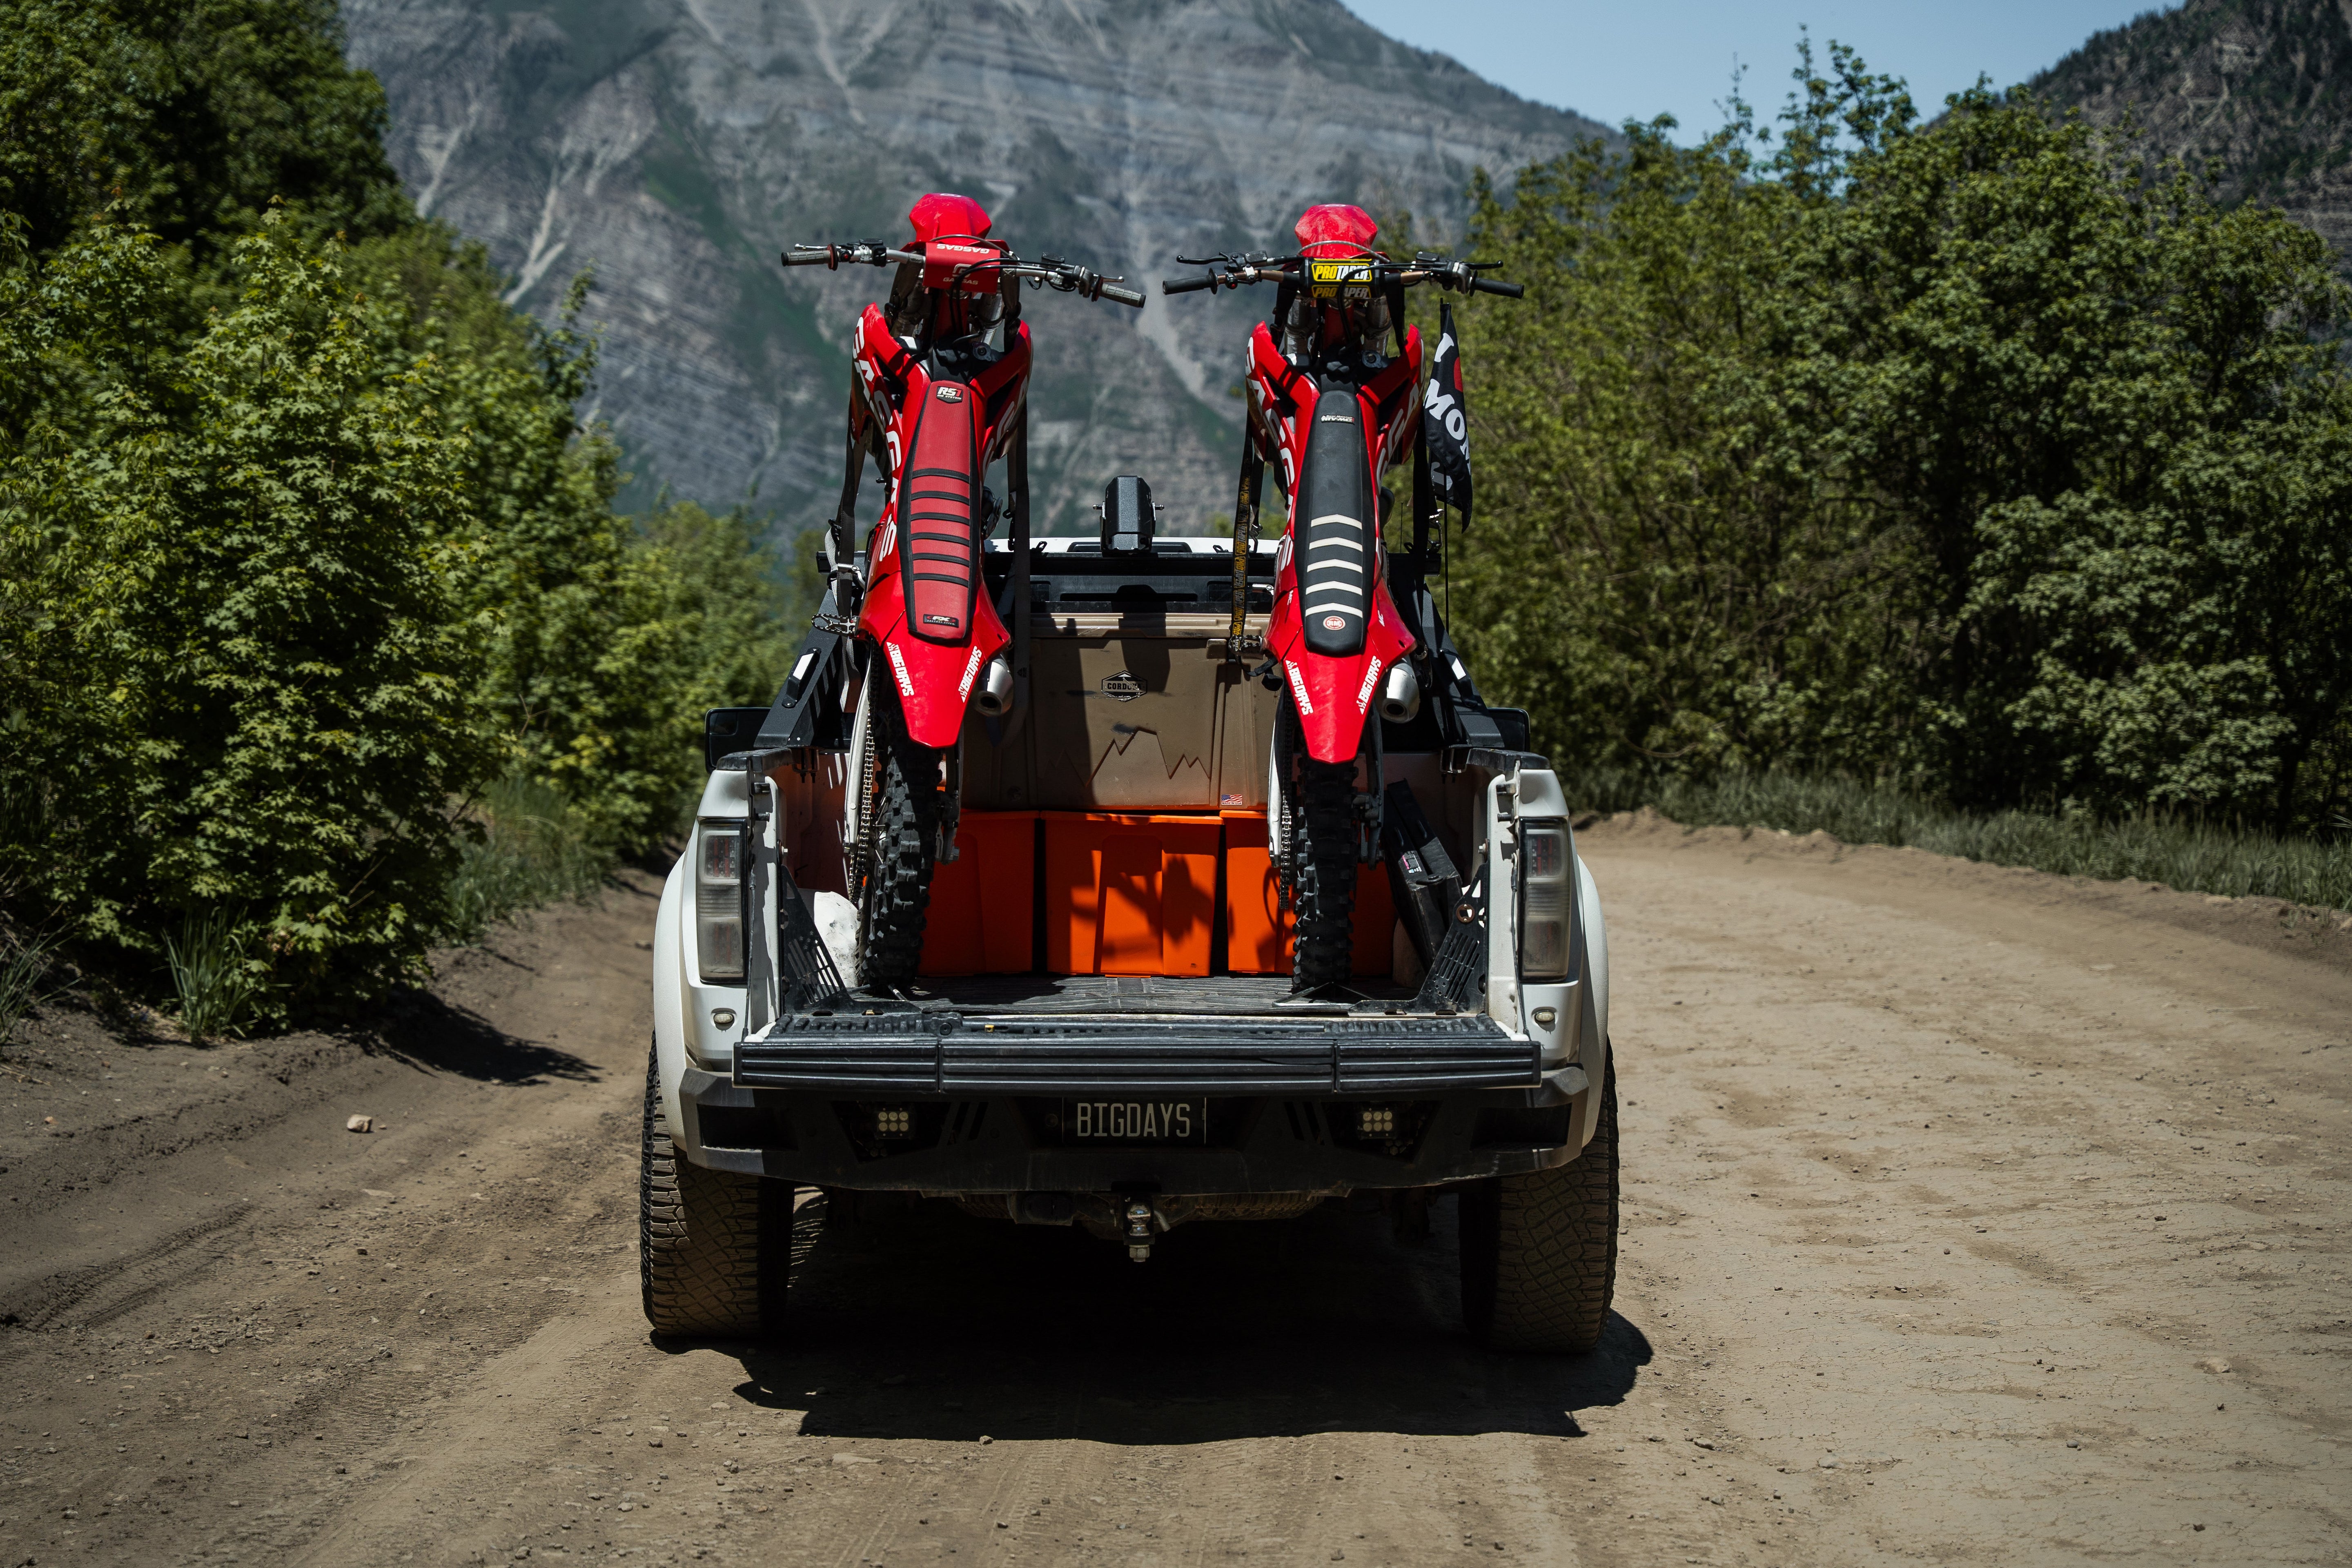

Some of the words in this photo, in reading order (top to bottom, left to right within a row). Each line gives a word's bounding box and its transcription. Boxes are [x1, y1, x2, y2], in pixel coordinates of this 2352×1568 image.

[937, 244, 990, 254] GASGAS
[1315, 287, 1368, 298] PROAPER
[938, 387, 962, 396] RS1
[890, 648, 915, 697] BIGDAYS
[960, 646, 982, 693] BIGDAYS
[1358, 655, 1382, 704] BIGDAYS
[1288, 666, 1314, 715] BIGDAYS
[1077, 1103, 1190, 1137] BIGDAYS
